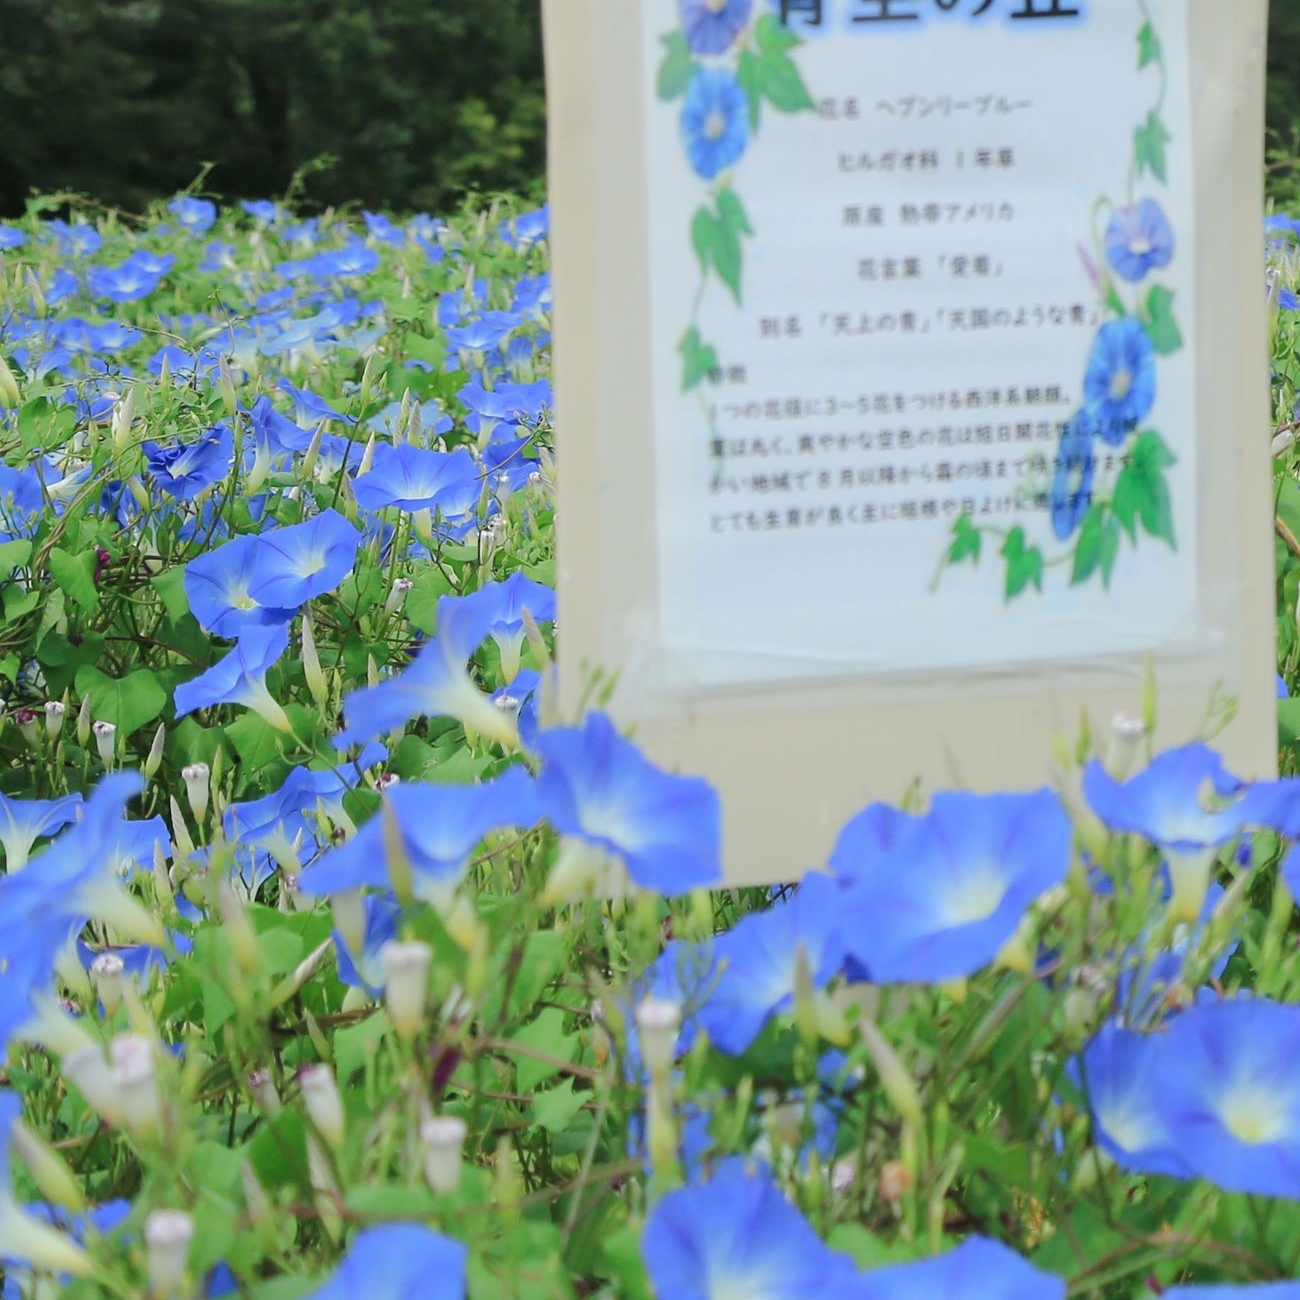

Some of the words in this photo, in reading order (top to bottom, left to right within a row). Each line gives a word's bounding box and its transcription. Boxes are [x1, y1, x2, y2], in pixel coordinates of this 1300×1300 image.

[876, 94, 1033, 118] ヘブンリーブルー
[838, 148, 938, 172] ヒルガオ科
[843, 204, 884, 227] 原産
[900, 201, 1015, 225] 熱帯アメリカ
